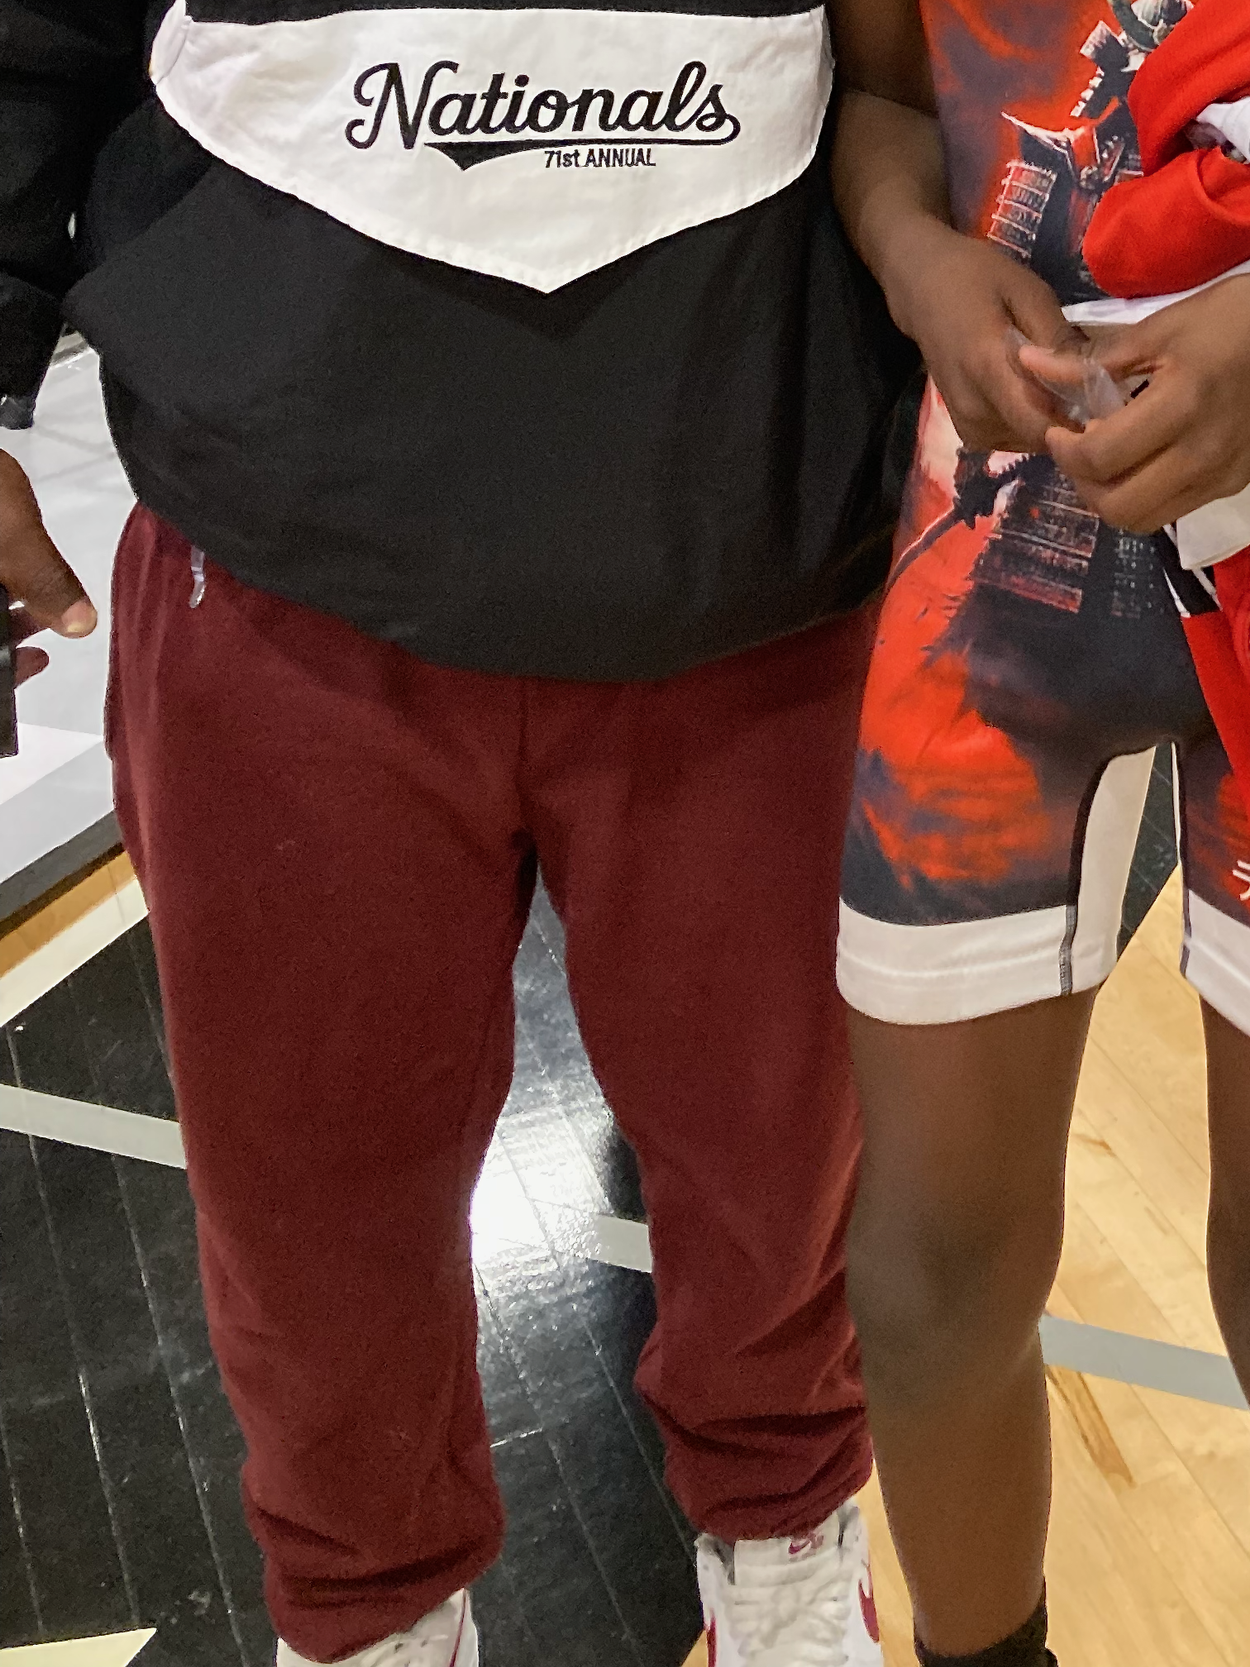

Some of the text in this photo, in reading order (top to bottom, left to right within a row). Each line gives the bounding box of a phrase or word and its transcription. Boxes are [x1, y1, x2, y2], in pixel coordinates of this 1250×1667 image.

[345, 60, 741, 150] Nationals
[545, 148, 656, 168] 71st ANNUAL
